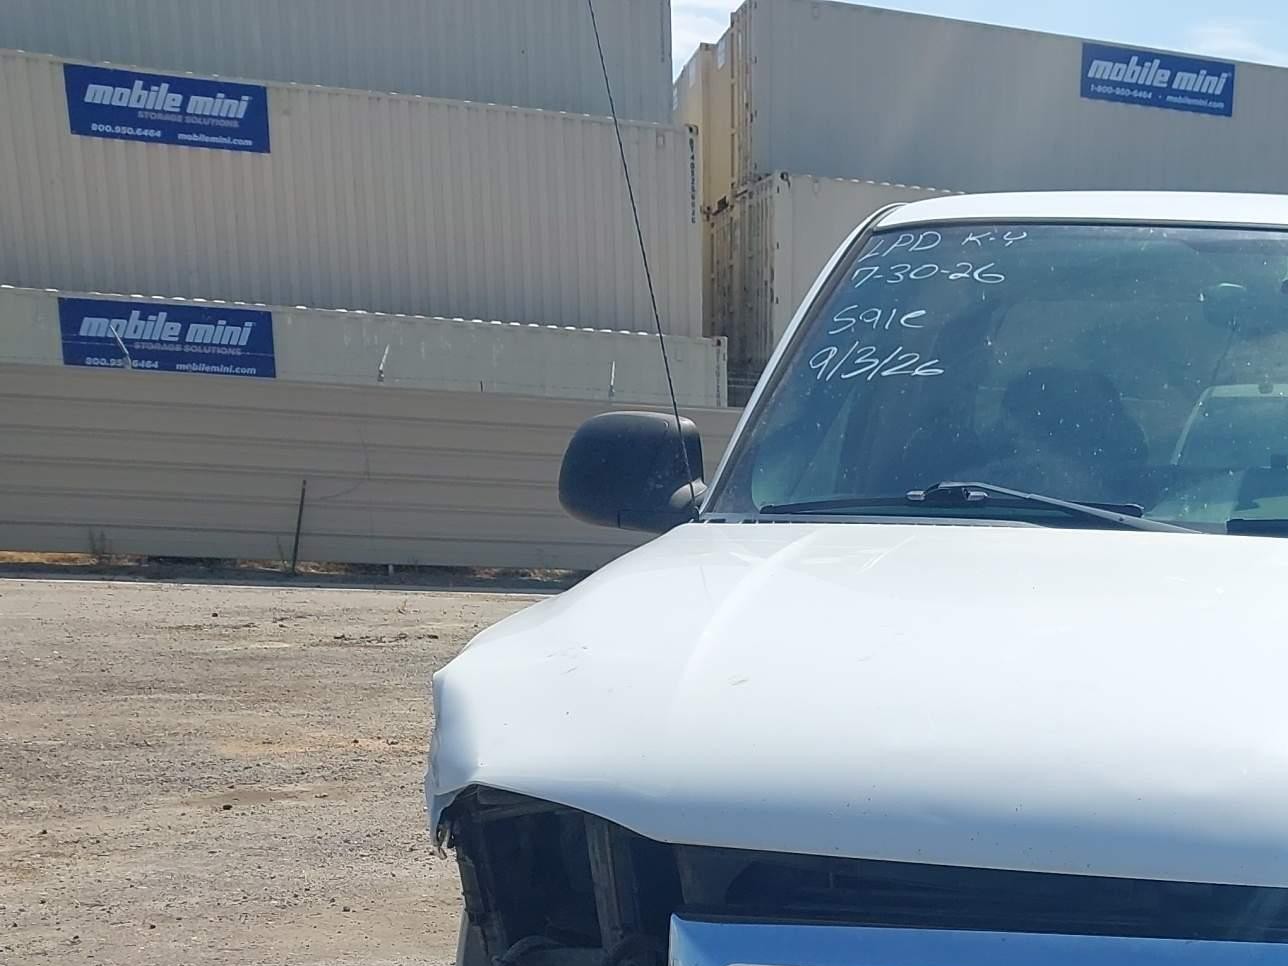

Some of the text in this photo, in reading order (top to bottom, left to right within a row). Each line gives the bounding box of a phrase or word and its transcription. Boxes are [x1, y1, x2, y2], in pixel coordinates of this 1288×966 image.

[1088, 56, 1227, 95] mobile mini
[84, 80, 250, 119] mobile mini
[177, 132, 252, 147] mobilemini.com
[851, 262, 1005, 288] 7-30-26
[79, 310, 253, 346] mobile mini
[176, 362, 256, 375] mobilemini.com
[809, 341, 944, 381] 9/3/26
